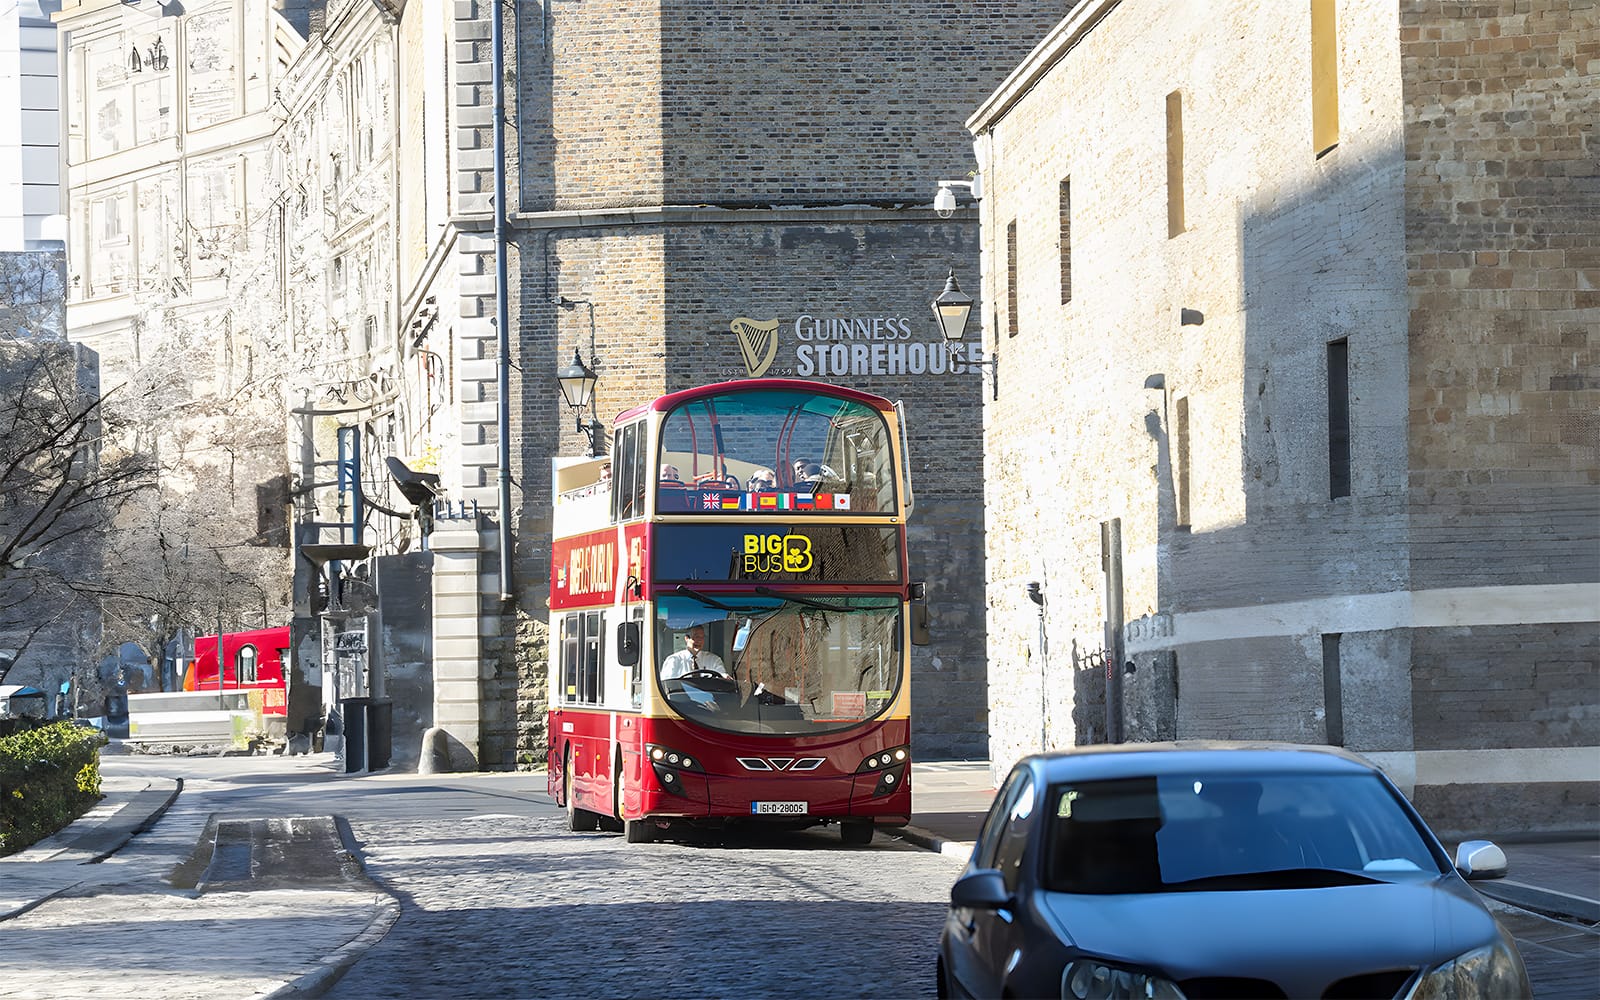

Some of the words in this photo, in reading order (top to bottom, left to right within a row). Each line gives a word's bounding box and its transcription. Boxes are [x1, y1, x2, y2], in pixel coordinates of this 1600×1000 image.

[795, 315, 912, 341] GUINNESS
[770, 368, 792, 376] 1759
[744, 535, 782, 554] BIG
[744, 555, 782, 572] BUS
